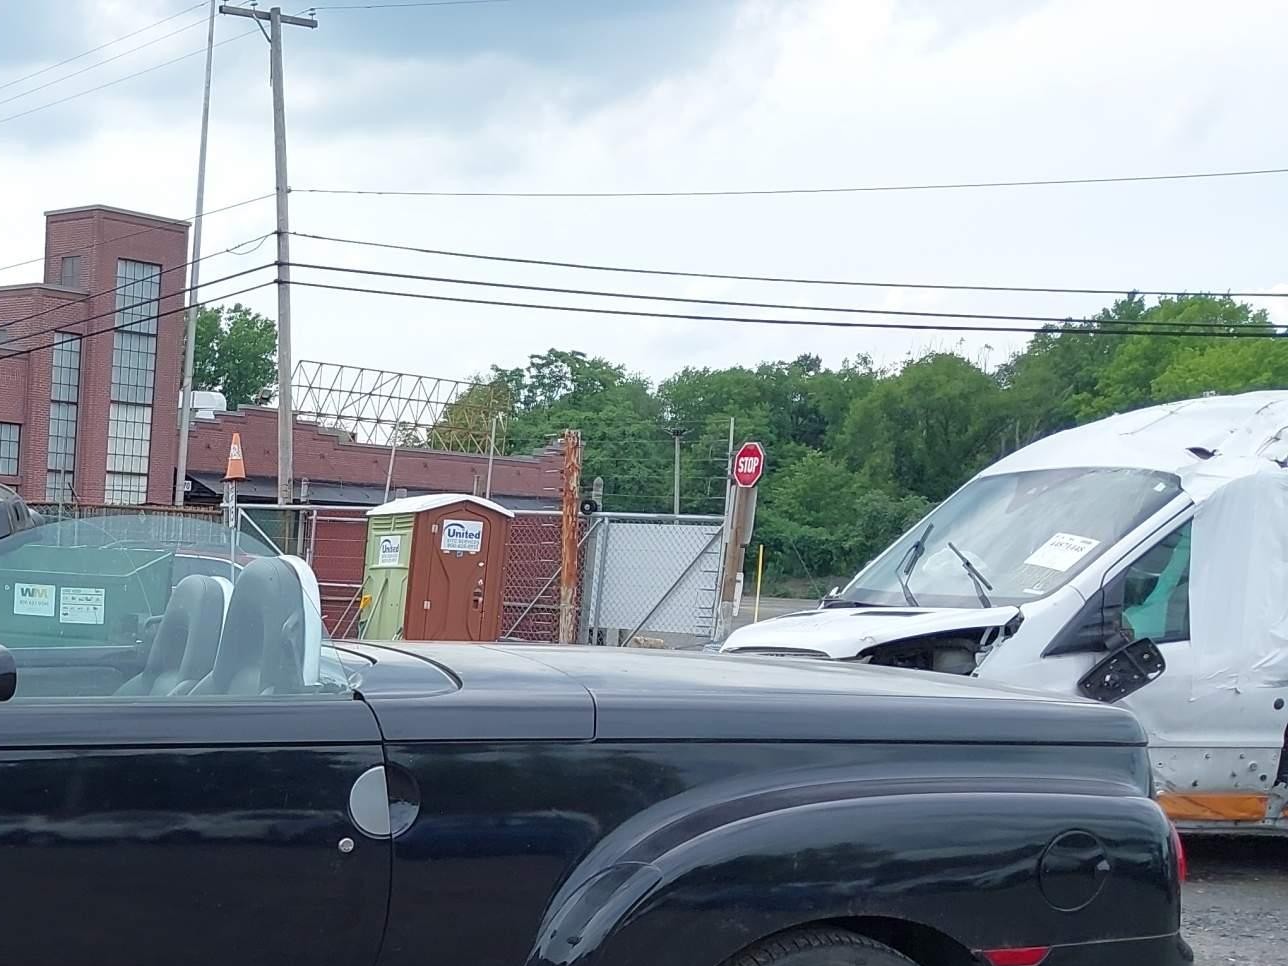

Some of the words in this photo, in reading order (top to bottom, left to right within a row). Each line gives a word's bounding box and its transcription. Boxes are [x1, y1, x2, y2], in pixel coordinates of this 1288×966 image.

[738, 456, 759, 473] STOP
[447, 528, 481, 540] United
[20, 587, 48, 598] WM
